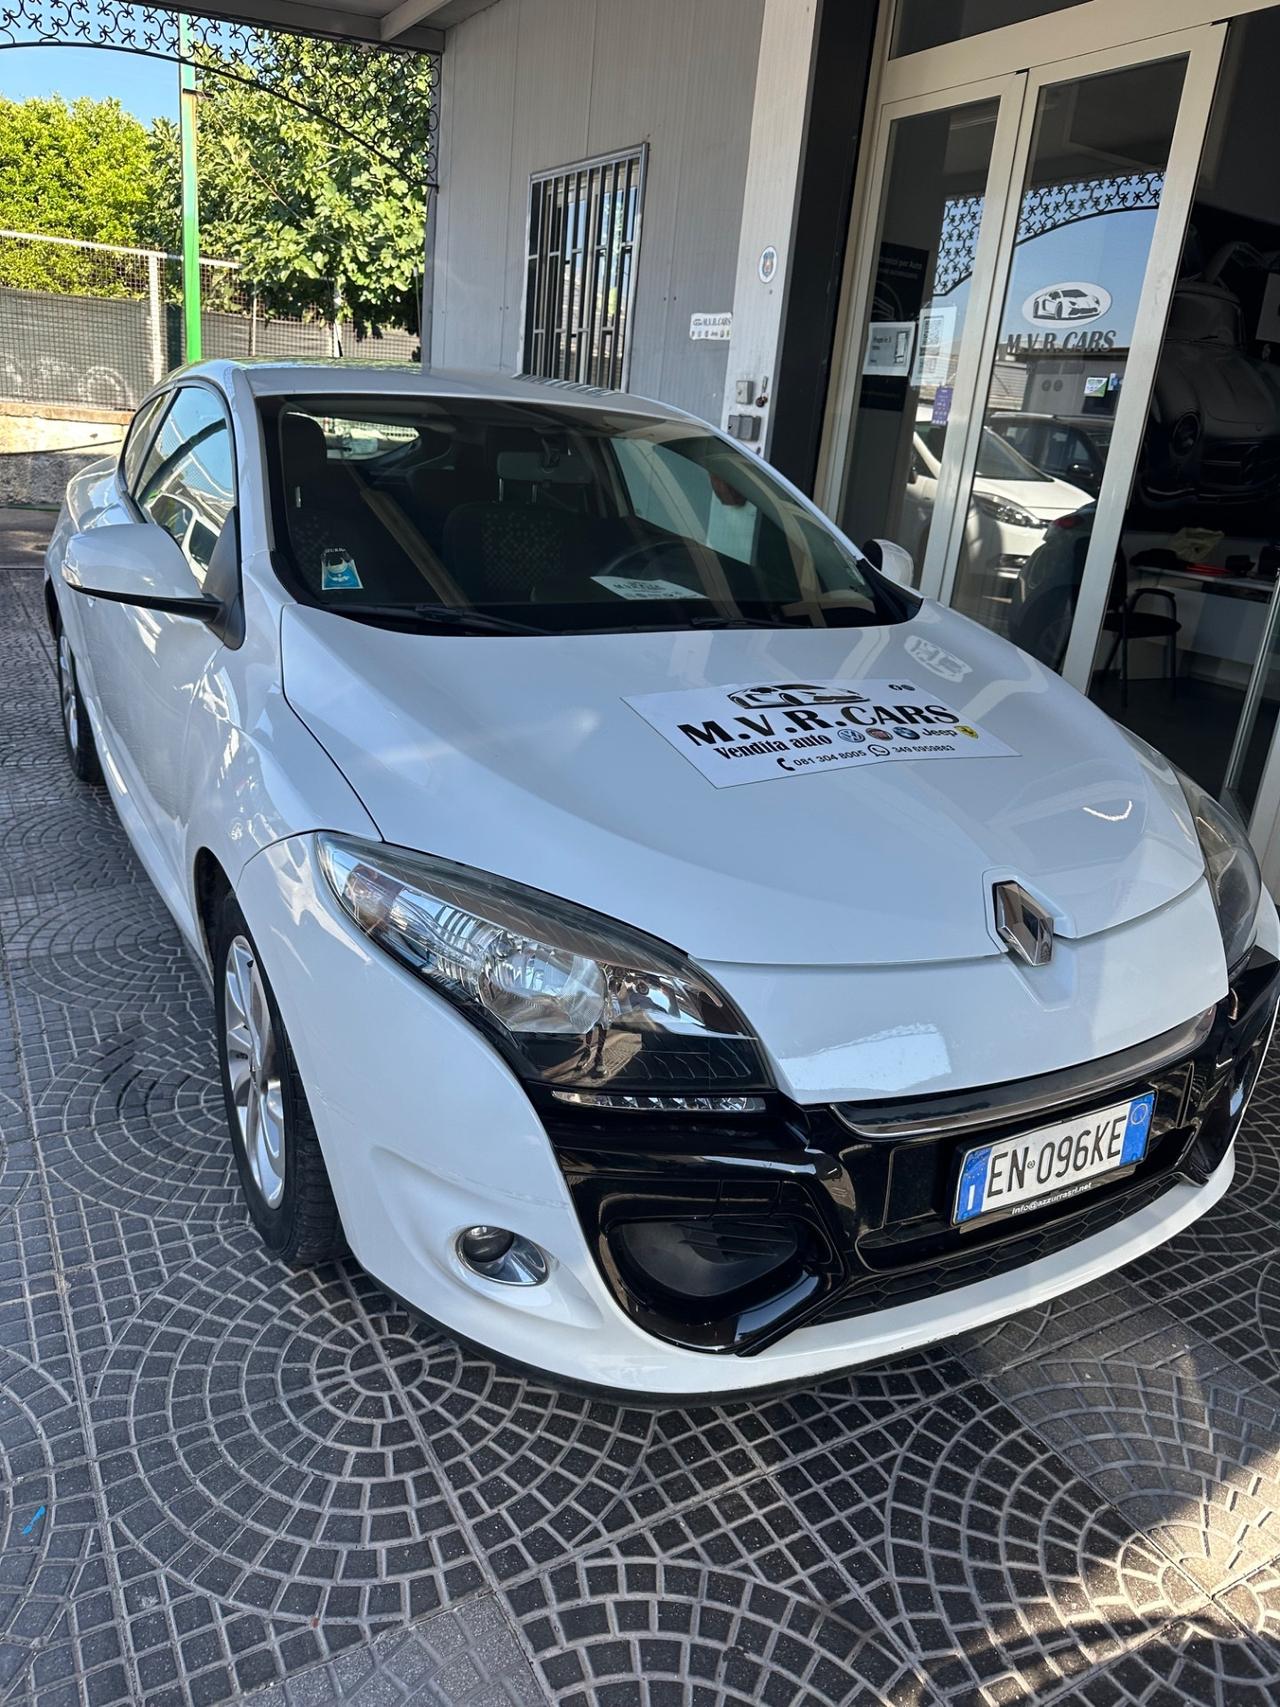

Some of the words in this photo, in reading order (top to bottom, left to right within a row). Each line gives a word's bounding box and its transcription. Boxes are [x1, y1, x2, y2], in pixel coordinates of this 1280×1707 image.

[789, 734, 833, 749] auto
[922, 728, 958, 737] Jeep
[793, 757, 816, 767] 081
[816, 754, 839, 763] 304
[838, 750, 867, 759] 8005
